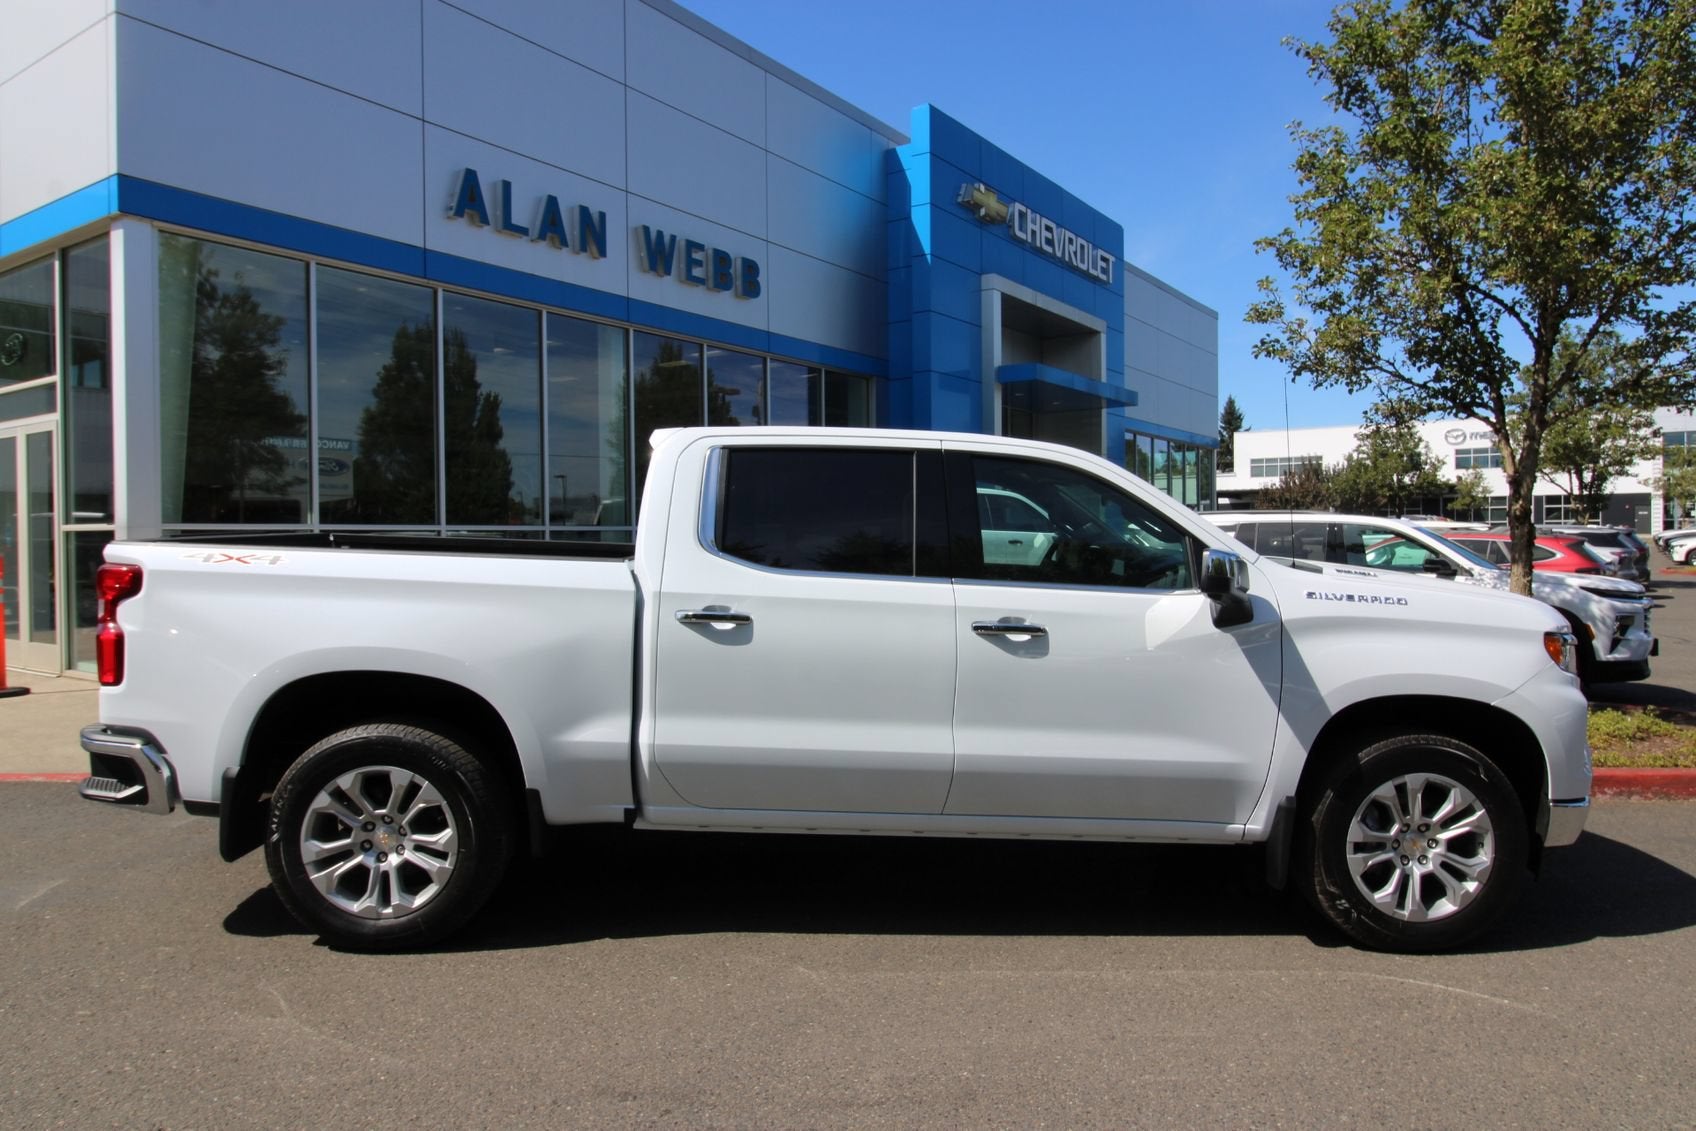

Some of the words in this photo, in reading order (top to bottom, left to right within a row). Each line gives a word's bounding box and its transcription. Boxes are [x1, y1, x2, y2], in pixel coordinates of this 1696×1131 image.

[449, 167, 607, 260] ALAN
[636, 223, 762, 301] WEBB
[1011, 201, 1116, 284] CHEVROLET
[1305, 591, 1409, 606] SILVERADO
